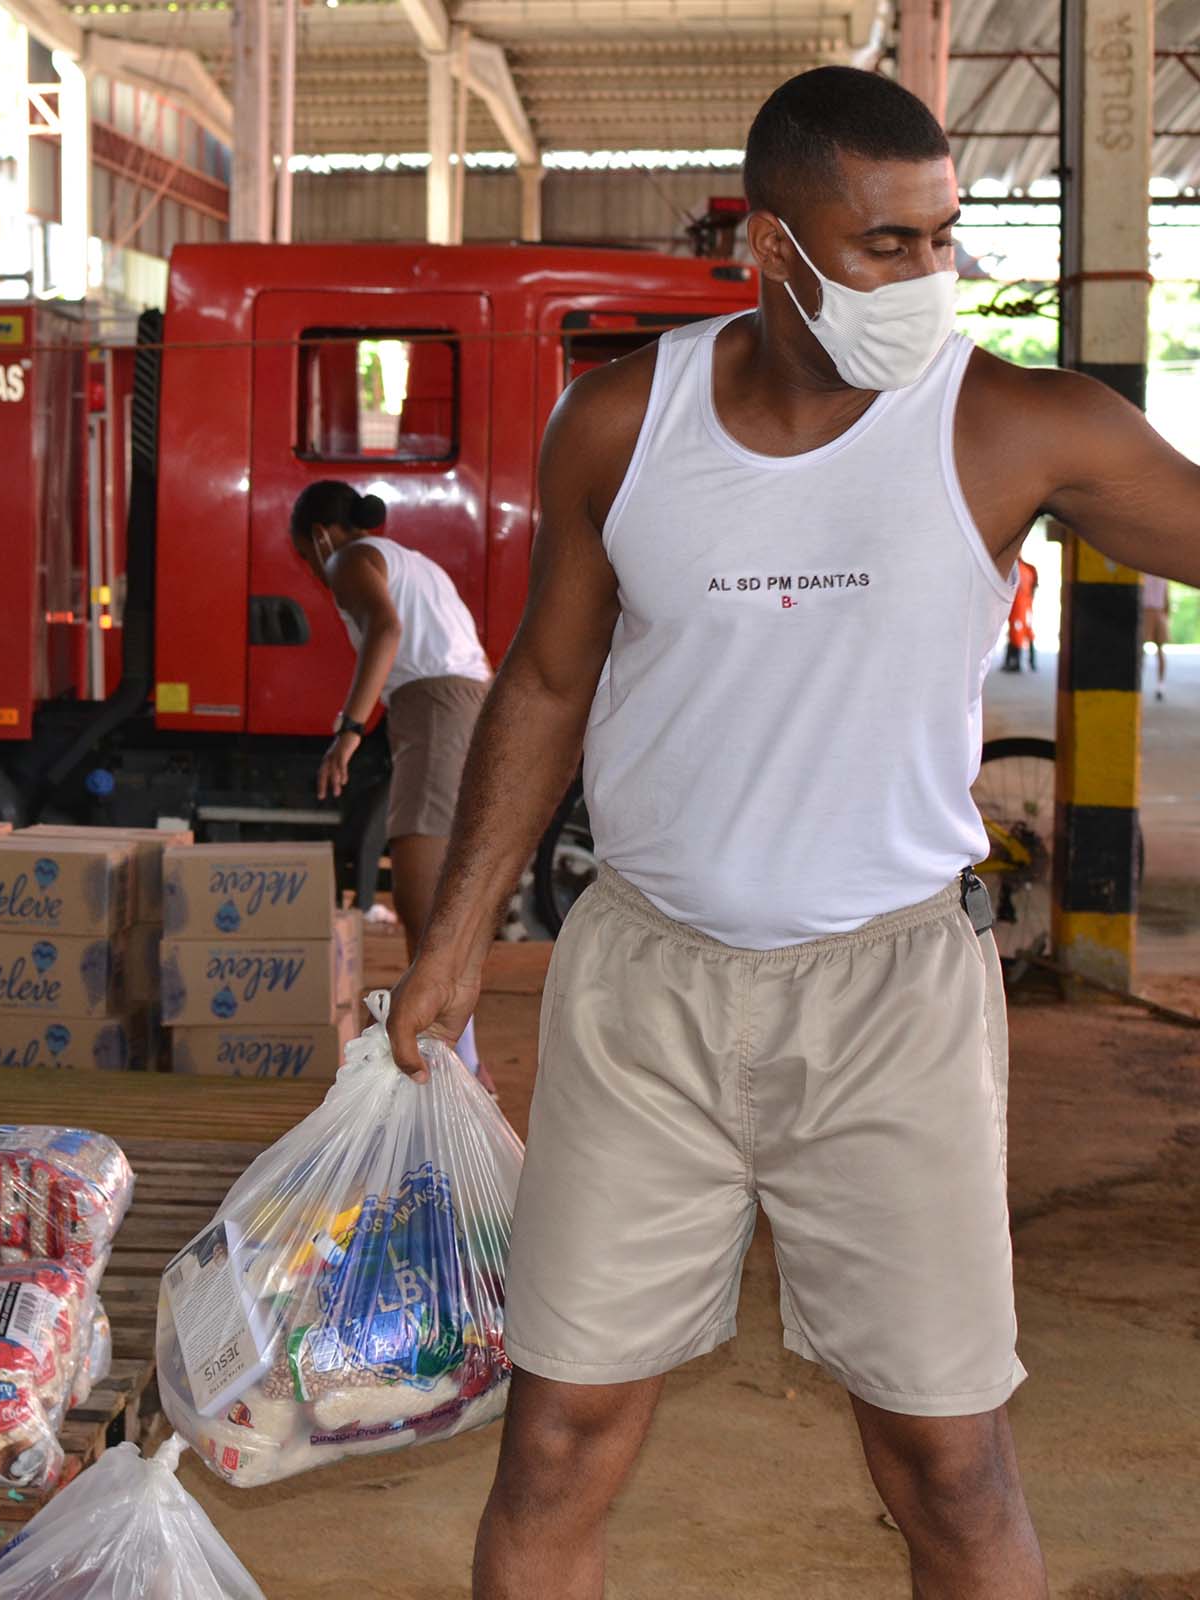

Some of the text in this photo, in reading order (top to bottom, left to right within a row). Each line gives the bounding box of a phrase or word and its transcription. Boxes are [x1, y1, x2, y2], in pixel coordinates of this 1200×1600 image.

[708, 572, 870, 593] AL SD PM DANTAS
[209, 869, 308, 916] Meleve
[205, 957, 305, 1001] Meleve
[204, 1342, 240, 1381] JESUS
